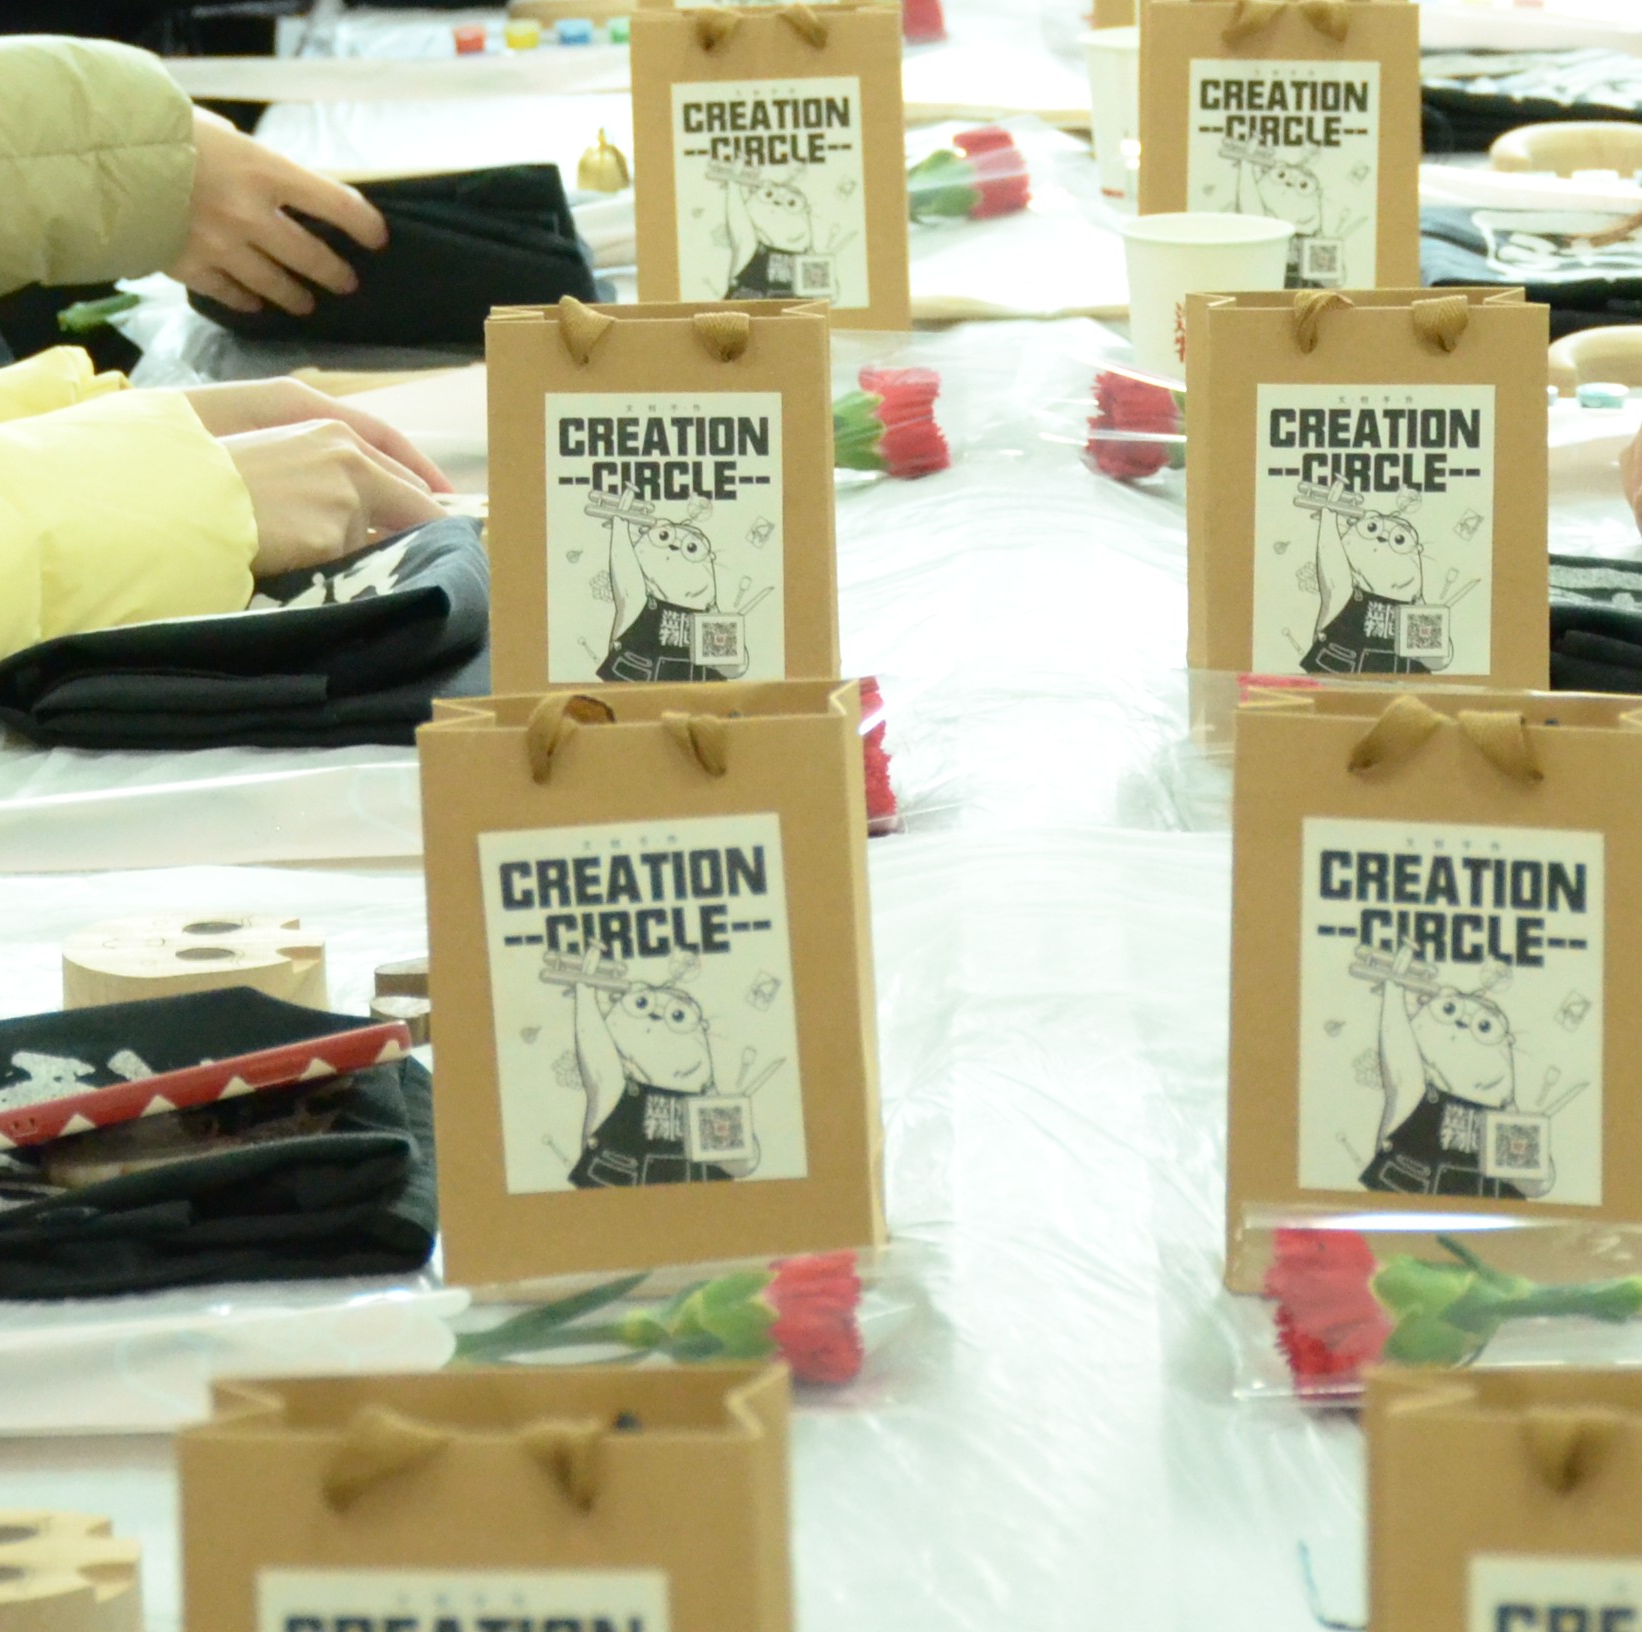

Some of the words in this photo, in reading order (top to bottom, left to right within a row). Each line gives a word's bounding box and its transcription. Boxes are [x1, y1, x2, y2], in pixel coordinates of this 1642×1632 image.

[683, 96, 850, 133] CREATION
[1199, 79, 1368, 112] CREATION
[558, 416, 769, 457] CREATION
[1269, 407, 1480, 449] CREATION
[499, 845, 768, 911] CREATION
[1319, 849, 1587, 914] CREATION
